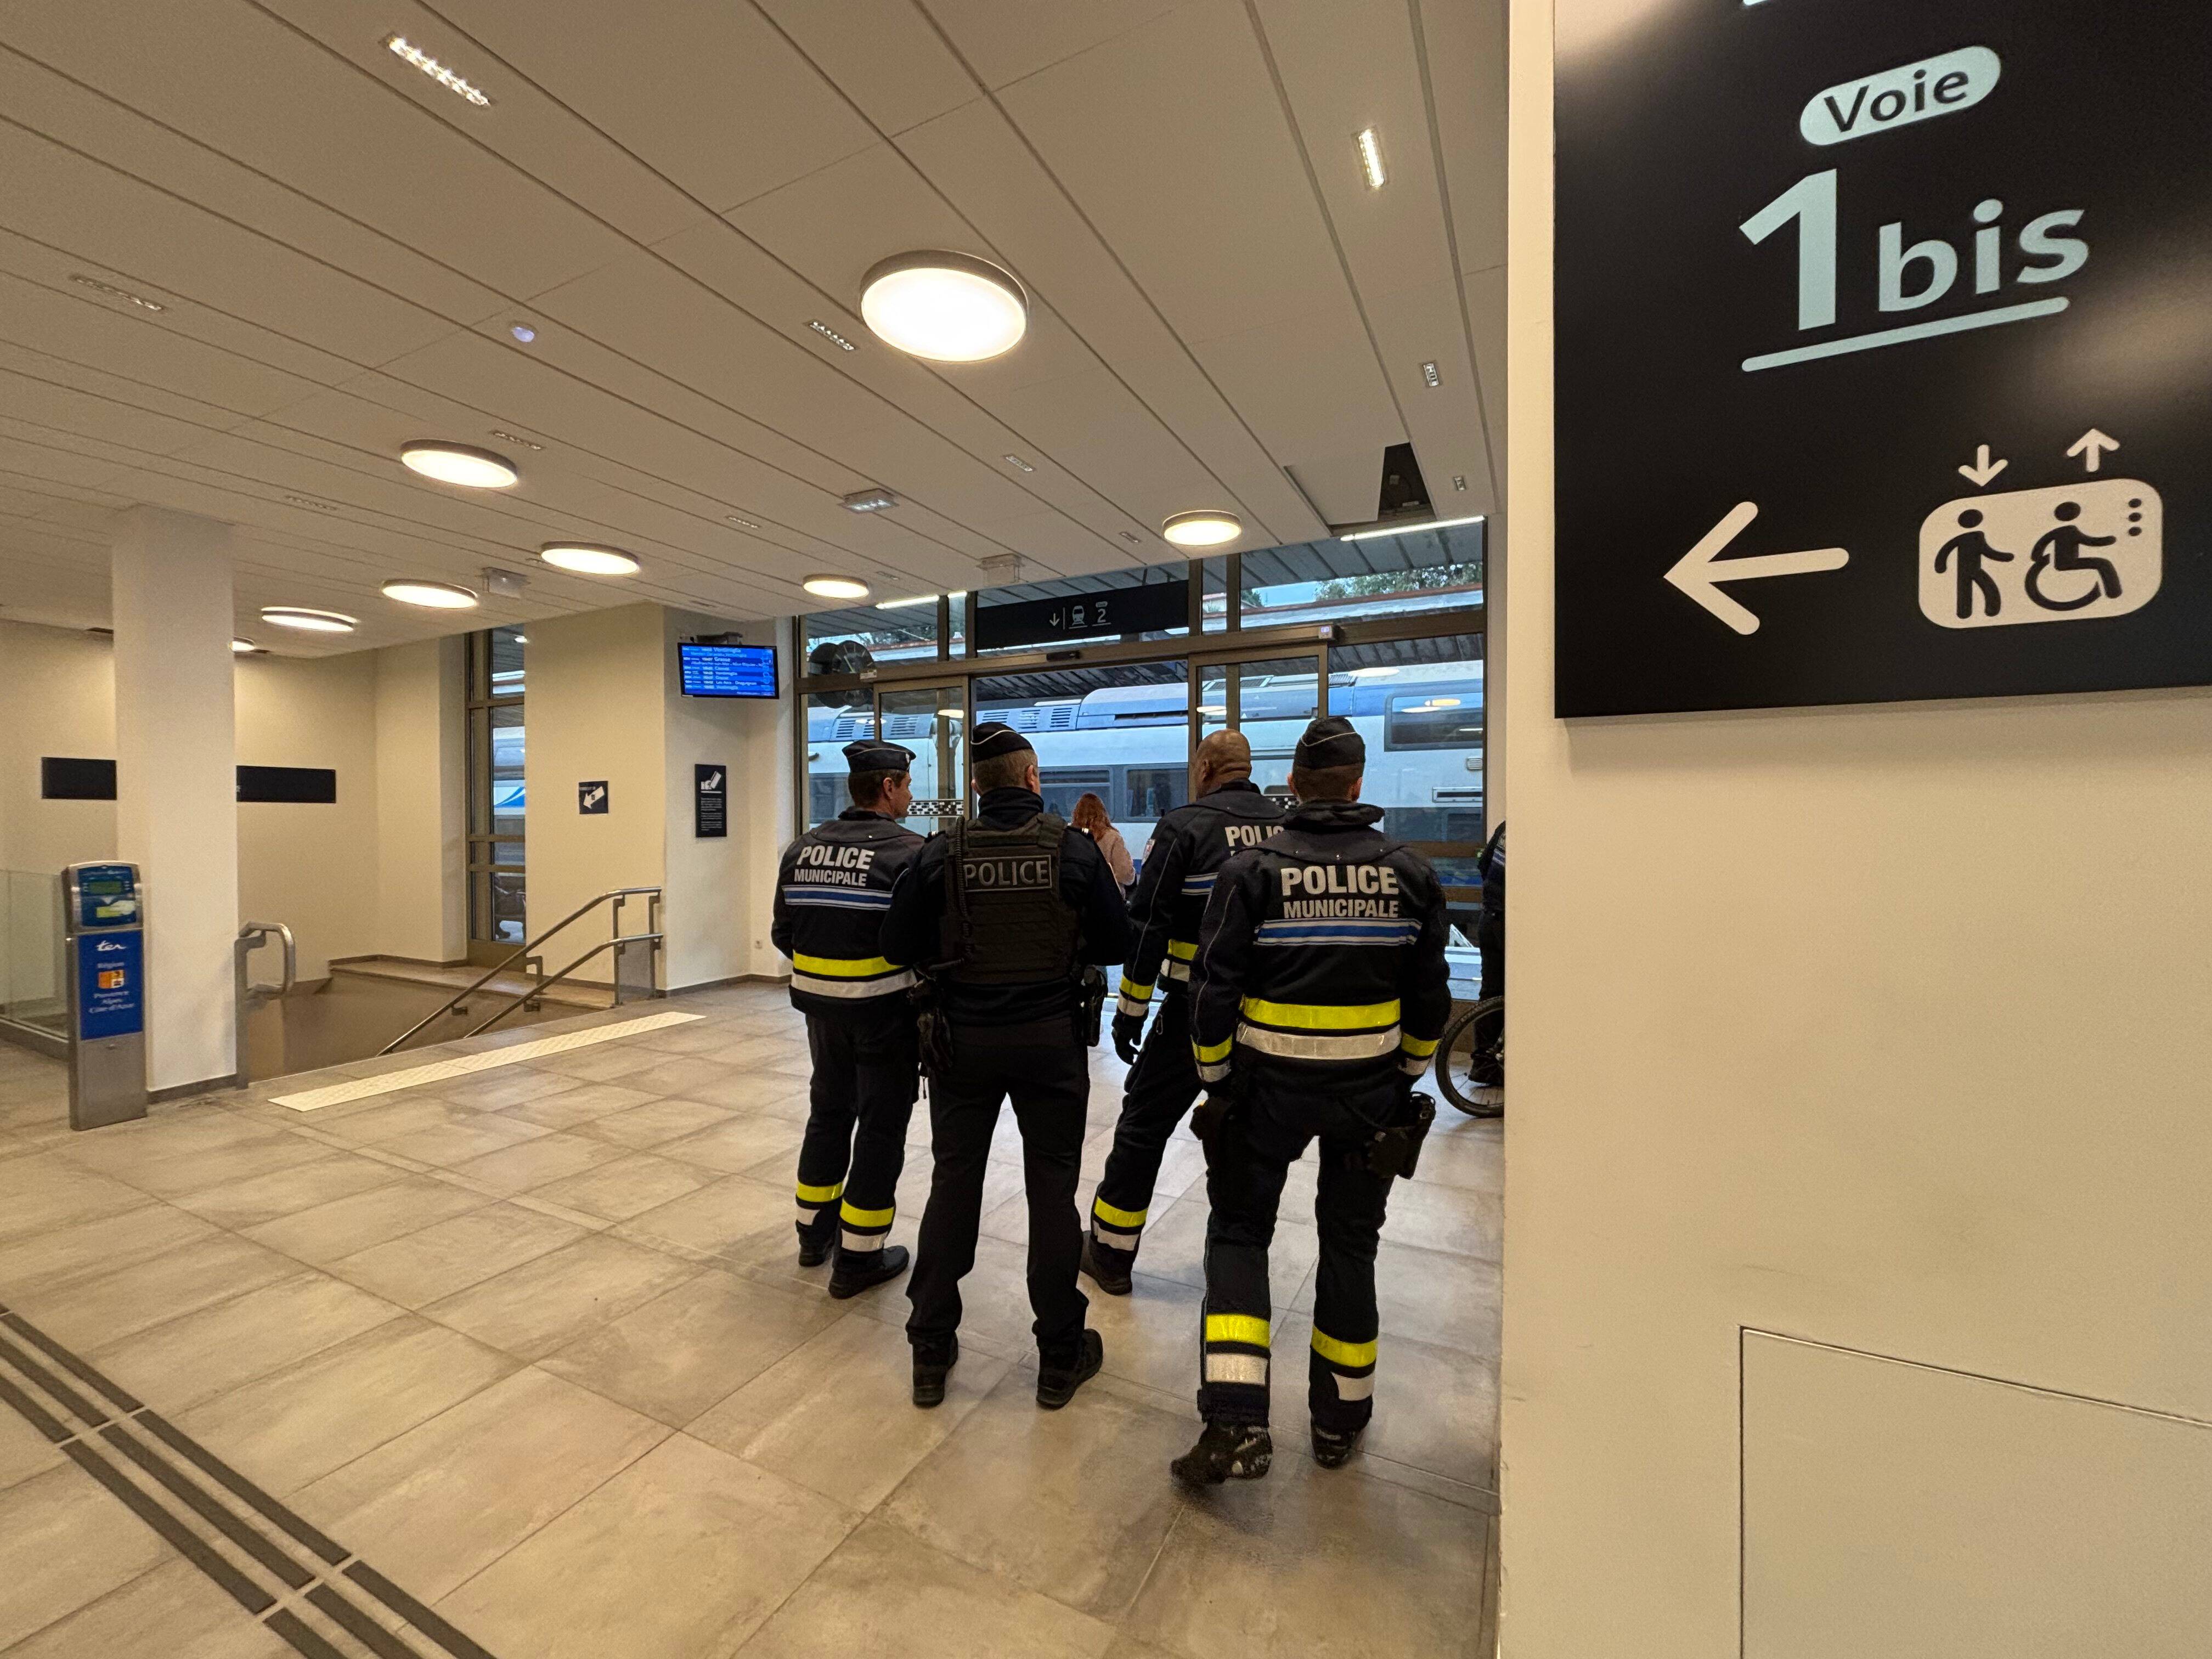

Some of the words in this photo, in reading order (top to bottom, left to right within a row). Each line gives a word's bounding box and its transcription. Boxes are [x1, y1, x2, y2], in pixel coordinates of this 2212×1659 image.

[1824, 69, 1969, 133] Voie
[1739, 168, 1837, 330] 1
[1878, 199, 2089, 312] bis
[1097, 608, 1106, 623] 2
[797, 845, 875, 870] POLICE
[794, 868, 867, 887] MUNICIPALE
[963, 860, 1049, 887] POLICE
[1280, 865, 1399, 896] POLICE
[1283, 899, 1399, 918] MUNICIPALE
